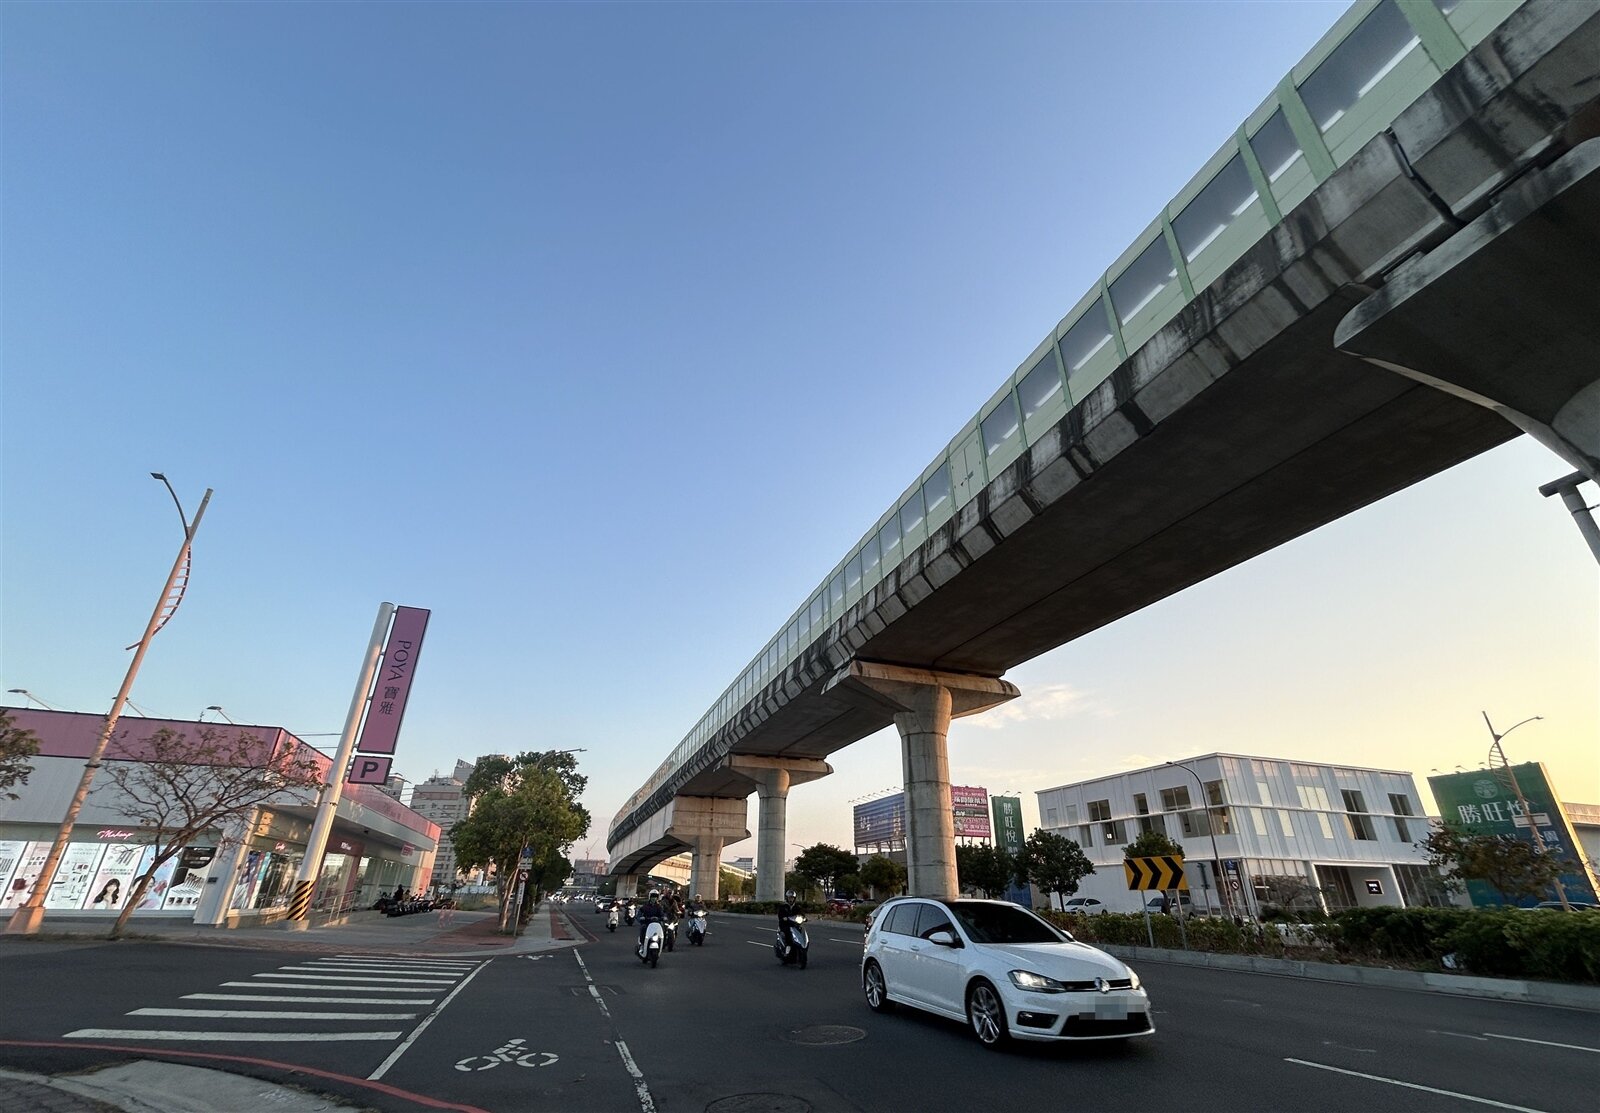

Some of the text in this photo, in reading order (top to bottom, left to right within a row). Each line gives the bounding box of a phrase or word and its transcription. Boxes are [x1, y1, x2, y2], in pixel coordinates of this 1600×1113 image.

[379, 640, 412, 715] POYA 寶雅
[360, 761, 379, 778] P
